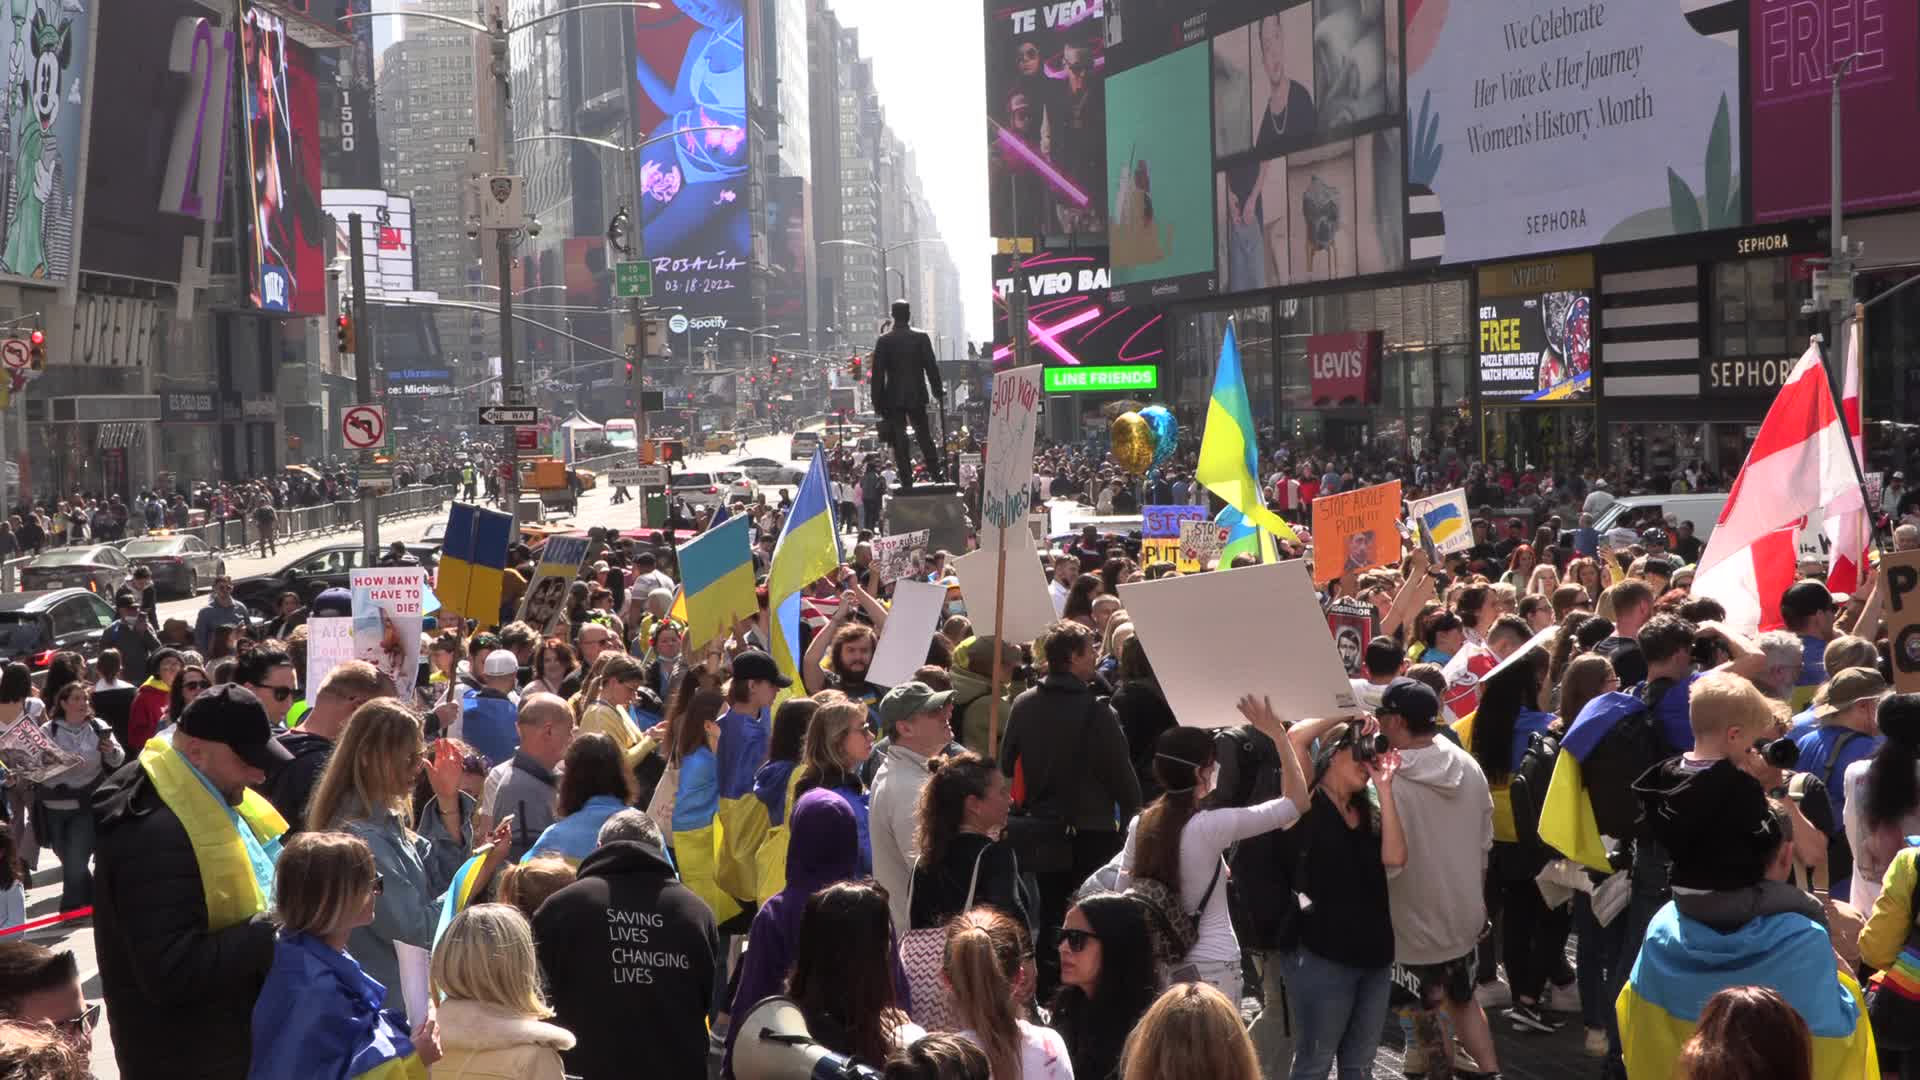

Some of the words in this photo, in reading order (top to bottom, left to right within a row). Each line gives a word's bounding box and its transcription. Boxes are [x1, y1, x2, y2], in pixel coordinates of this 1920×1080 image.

[1011, 8, 1036, 34] TE
[1043, 0, 1086, 28] VEO
[1504, 20, 1528, 51] We
[1531, 2, 1605, 45] Celebrate
[1762, 0, 1884, 92] FREE
[1474, 79, 1498, 109] Her
[1501, 69, 1536, 101] Voice
[1539, 62, 1551, 93] &
[1556, 56, 1583, 88] Her
[1581, 44, 1644, 90] Journey
[341, 91, 354, 151] 1500
[1467, 113, 1532, 153] Women's
[1536, 107, 1593, 141] History
[1597, 87, 1654, 128] Month
[1527, 208, 1586, 235] SEPHORA
[1738, 234, 1789, 254] SEPHORA
[652, 250, 746, 274] ROSALÍA
[1028, 272, 1072, 297] VEO
[1480, 306, 1492, 319] GET
[690, 318, 728, 331] Spotify
[1480, 318, 1521, 352] FREE
[1480, 354, 1502, 367] PUZZLE
[1502, 353, 1520, 367] WITH
[1520, 352, 1539, 366] EVERY
[1054, 372, 1087, 385] LINE
[1090, 371, 1152, 385] FRIENDS
[1481, 368, 1502, 381] WATCH
[1502, 367, 1534, 381] PURCHASE
[1711, 359, 1792, 387] SEPHOR
[487, 411, 504, 420] ONE
[512, 411, 530, 420] WAY
[1320, 498, 1350, 521] STOP
[873, 540, 897, 551] STOP
[354, 576, 384, 586] HOW
[388, 576, 420, 586] MANY
[371, 590, 402, 600] HAVE
[406, 589, 420, 599] TO
[396, 603, 420, 613] DIE?
[14, 727, 39, 755] PUTIN
[21, 720, 48, 749] STOP
[606, 908, 663, 928] SAVING
[609, 925, 649, 944] LIVES
[612, 948, 689, 969] CHANGING
[614, 967, 653, 984] LIVES
